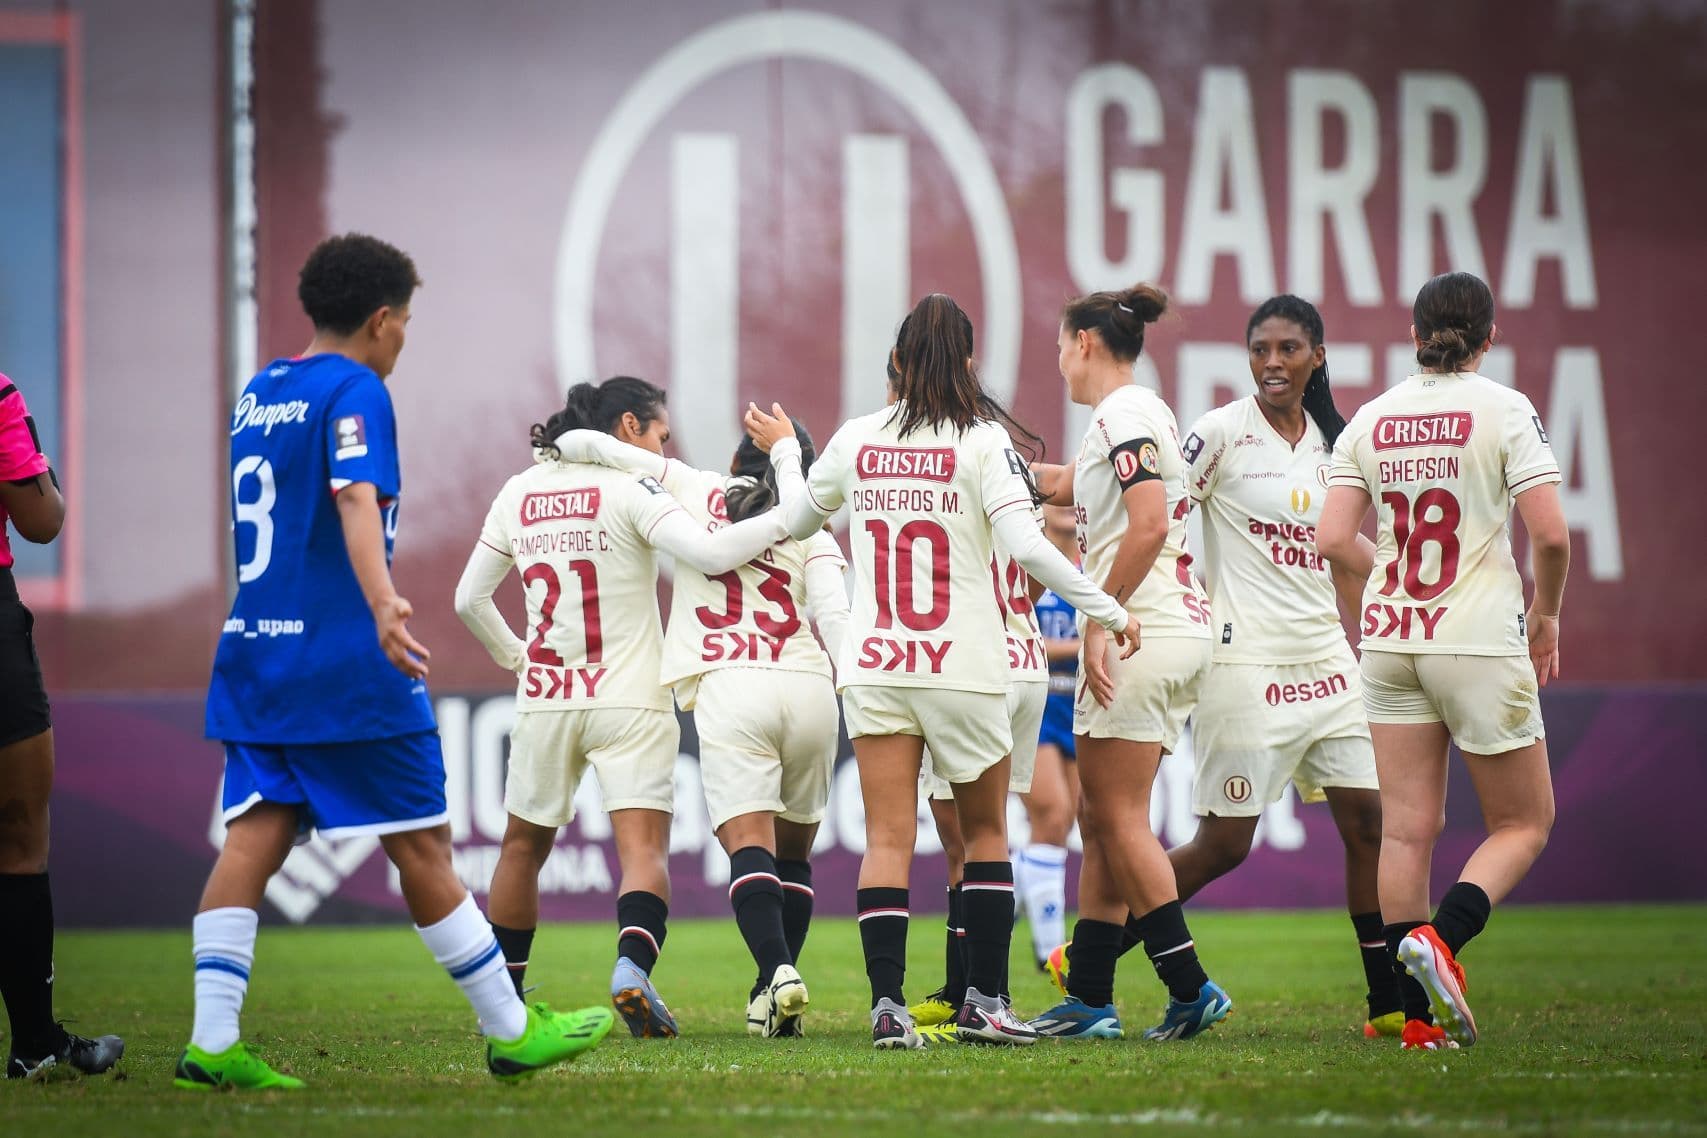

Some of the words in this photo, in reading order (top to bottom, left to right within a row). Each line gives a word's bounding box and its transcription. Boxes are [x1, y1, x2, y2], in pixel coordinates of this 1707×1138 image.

[1066, 62, 1598, 309] GARRA
[1378, 416, 1463, 444] CRISTAL
[861, 449, 949, 476] CRISTAL
[1242, 471, 1286, 480] marathon
[1380, 456, 1459, 484] GHERSON
[525, 492, 594, 520] CRISTAL
[853, 489, 933, 512] CISNEROS
[942, 491, 964, 515] M.
[511, 530, 594, 557] CAMPOVERDE
[599, 531, 613, 552] C.
[1248, 517, 1316, 542] apues
[1377, 487, 1461, 601] 18
[1271, 541, 1325, 571] total
[865, 519, 950, 632] 10
[522, 560, 601, 667] 21
[1363, 603, 1448, 640] SKY
[858, 637, 953, 674] SKY
[525, 666, 607, 700] SKY
